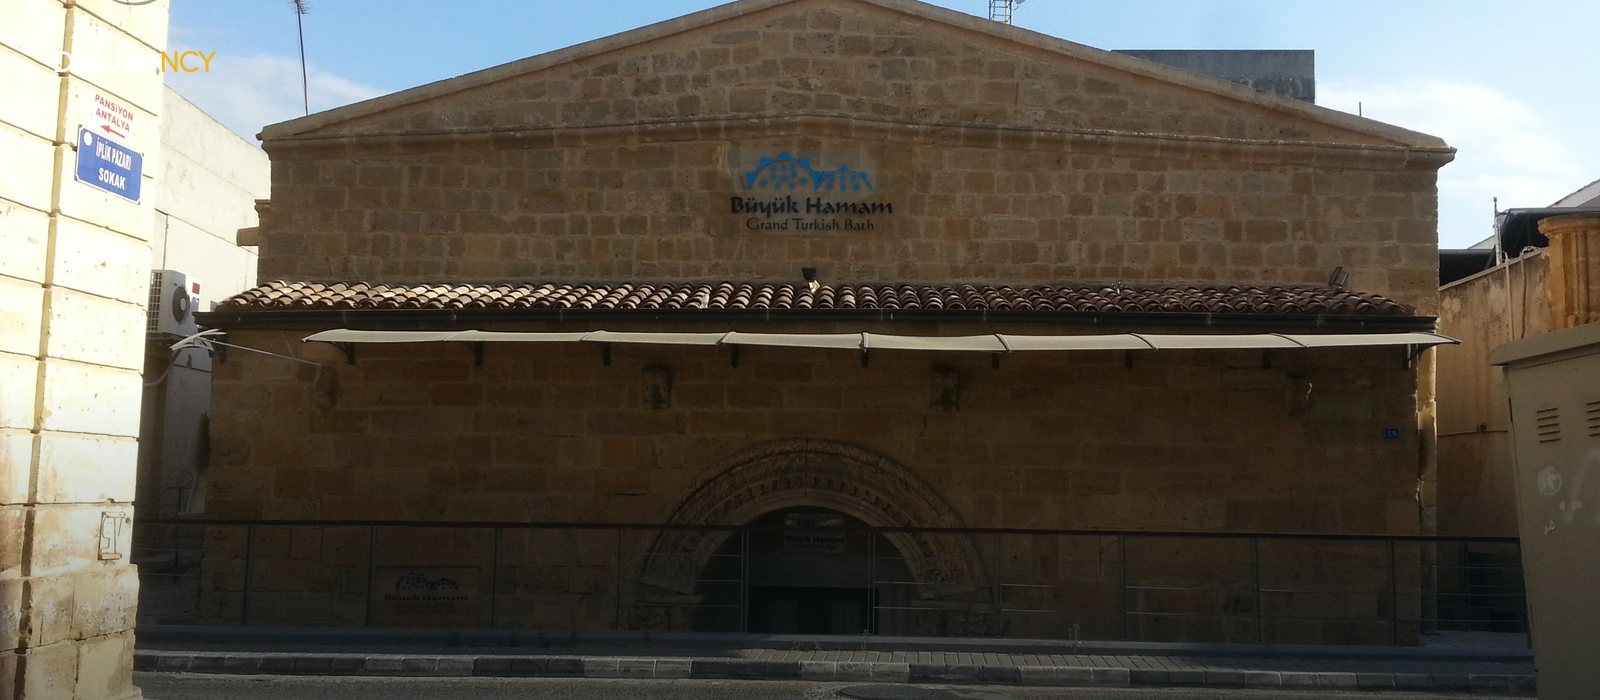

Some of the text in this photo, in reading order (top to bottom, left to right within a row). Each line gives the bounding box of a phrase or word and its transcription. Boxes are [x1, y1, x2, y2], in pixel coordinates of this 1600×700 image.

[95, 107, 130, 132] ANTALYA
[95, 137, 132, 171] İPLİK PAZARI
[98, 167, 126, 190] SOKAK
[729, 194, 893, 217] Büyük Hamam
[746, 217, 874, 231] Grand Turkish Bath
